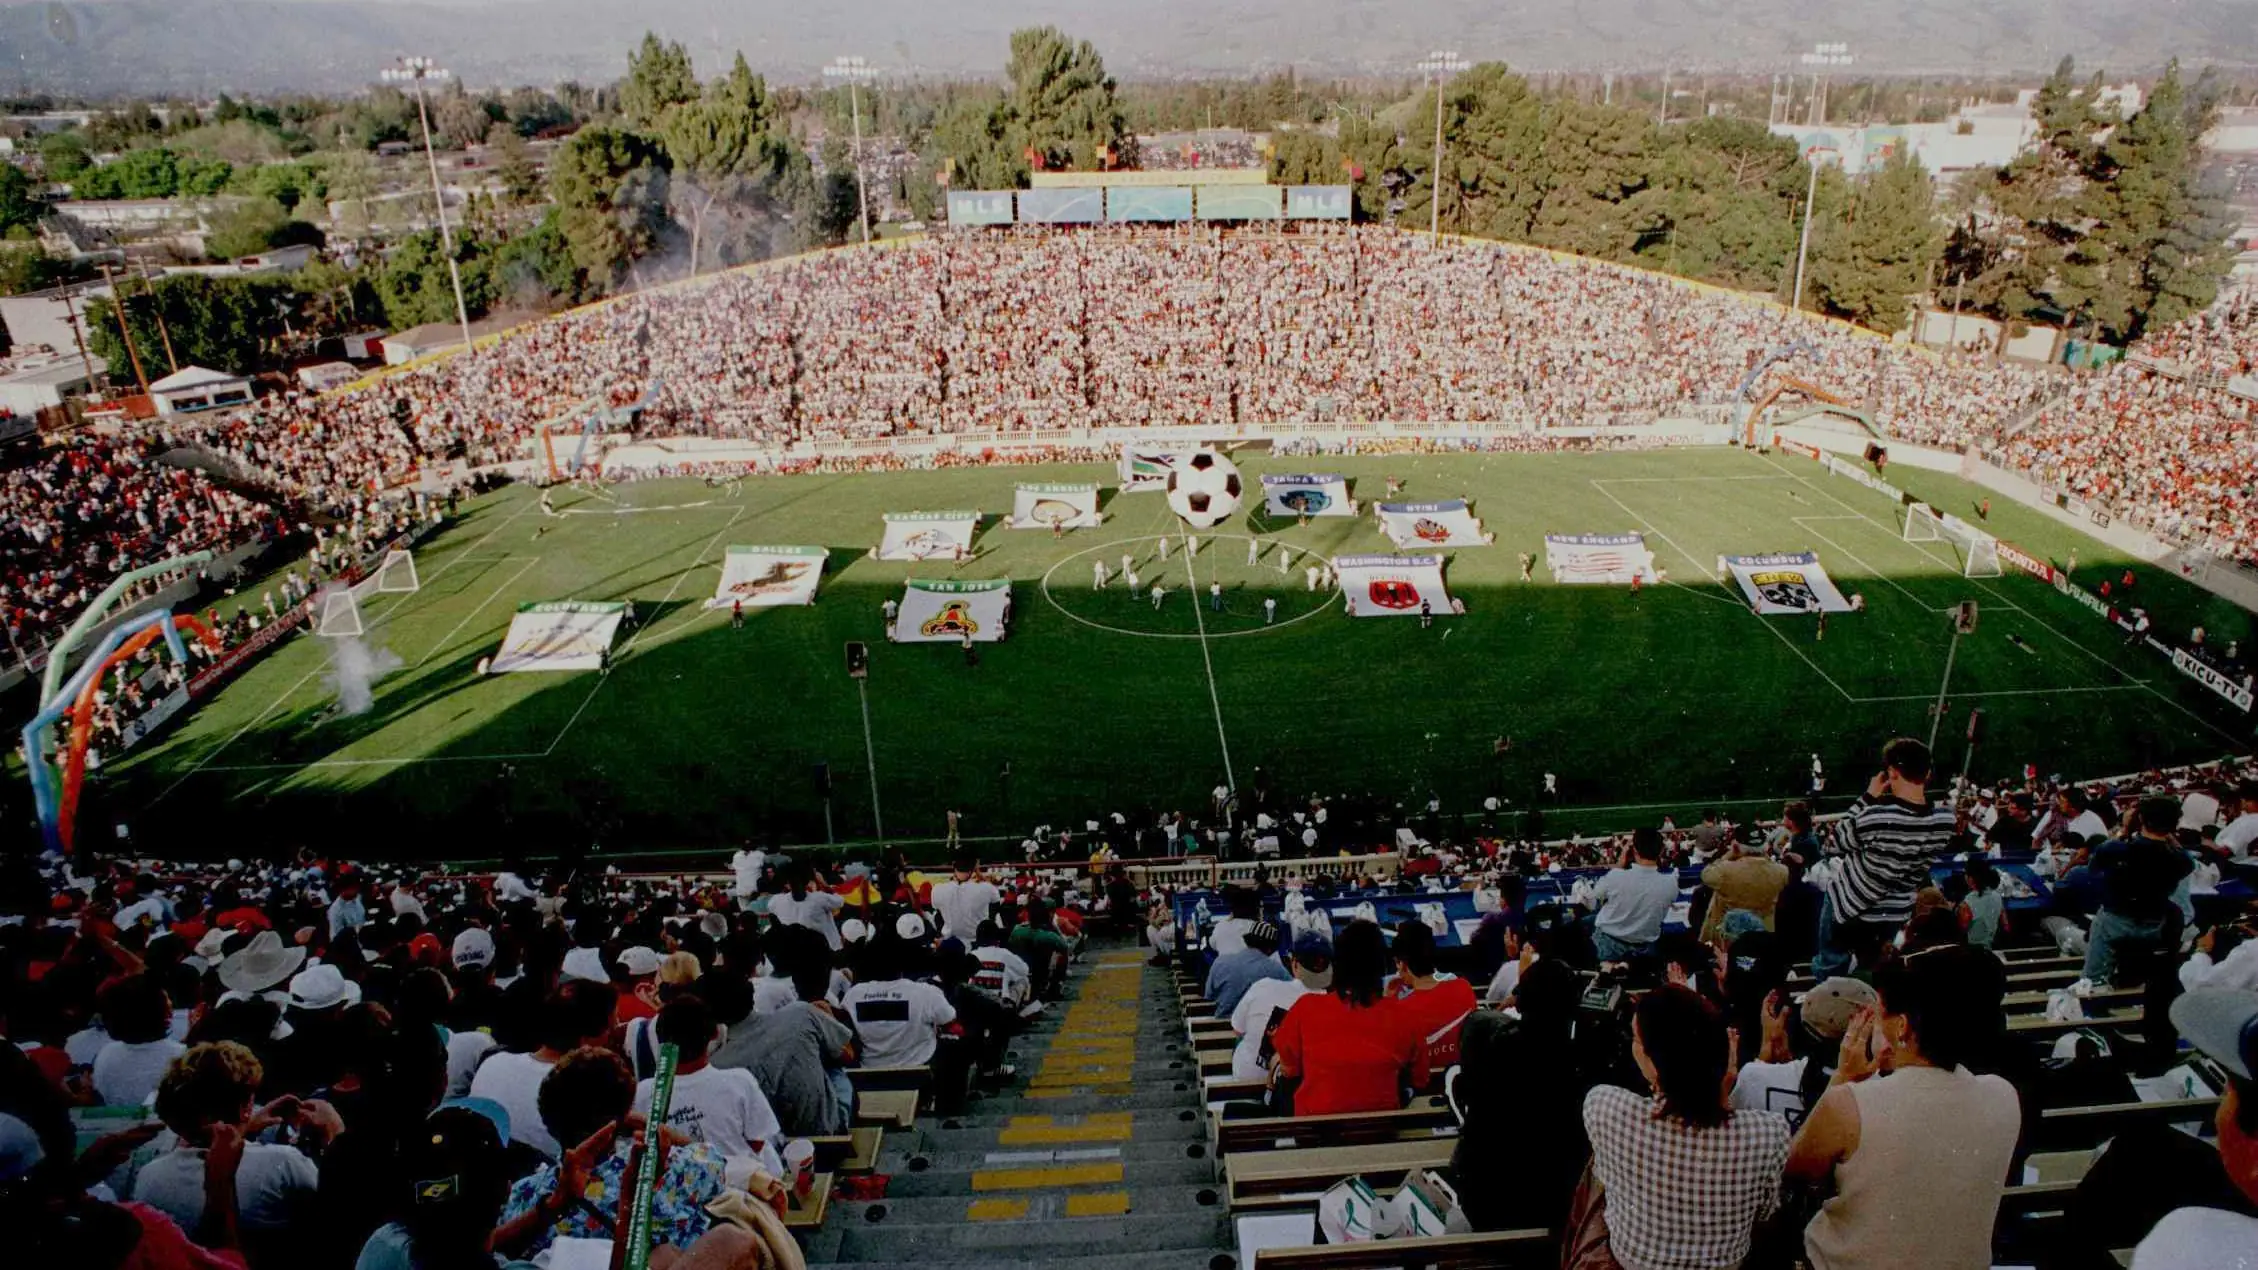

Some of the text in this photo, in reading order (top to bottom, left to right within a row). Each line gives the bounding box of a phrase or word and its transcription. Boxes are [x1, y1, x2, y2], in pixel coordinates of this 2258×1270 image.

[956, 199, 1005, 214] MLS
[1296, 194, 1342, 210] MLS
[1273, 475, 1333, 484] TAMPA BAY
[1020, 484, 1092, 492] LOS ANGELES
[894, 512, 971, 521] KANSAS CITY
[1553, 535, 1637, 545] NEW ENGLAND
[751, 546, 803, 554] DALLAS
[1339, 557, 1409, 567] WASHINGTON
[1739, 555, 1804, 565] COLUMBUS
[1997, 541, 2049, 581] HONDA
[928, 582, 992, 592] SAN JOSE
[535, 602, 610, 612] COLORADO
[2183, 658, 2240, 700] KICU-TV
[653, 1087, 664, 1110] APRIL
[643, 1159, 654, 1179] SAN
[637, 1183, 650, 1222] STADIUM
[631, 1225, 644, 1265] SPARTAN
